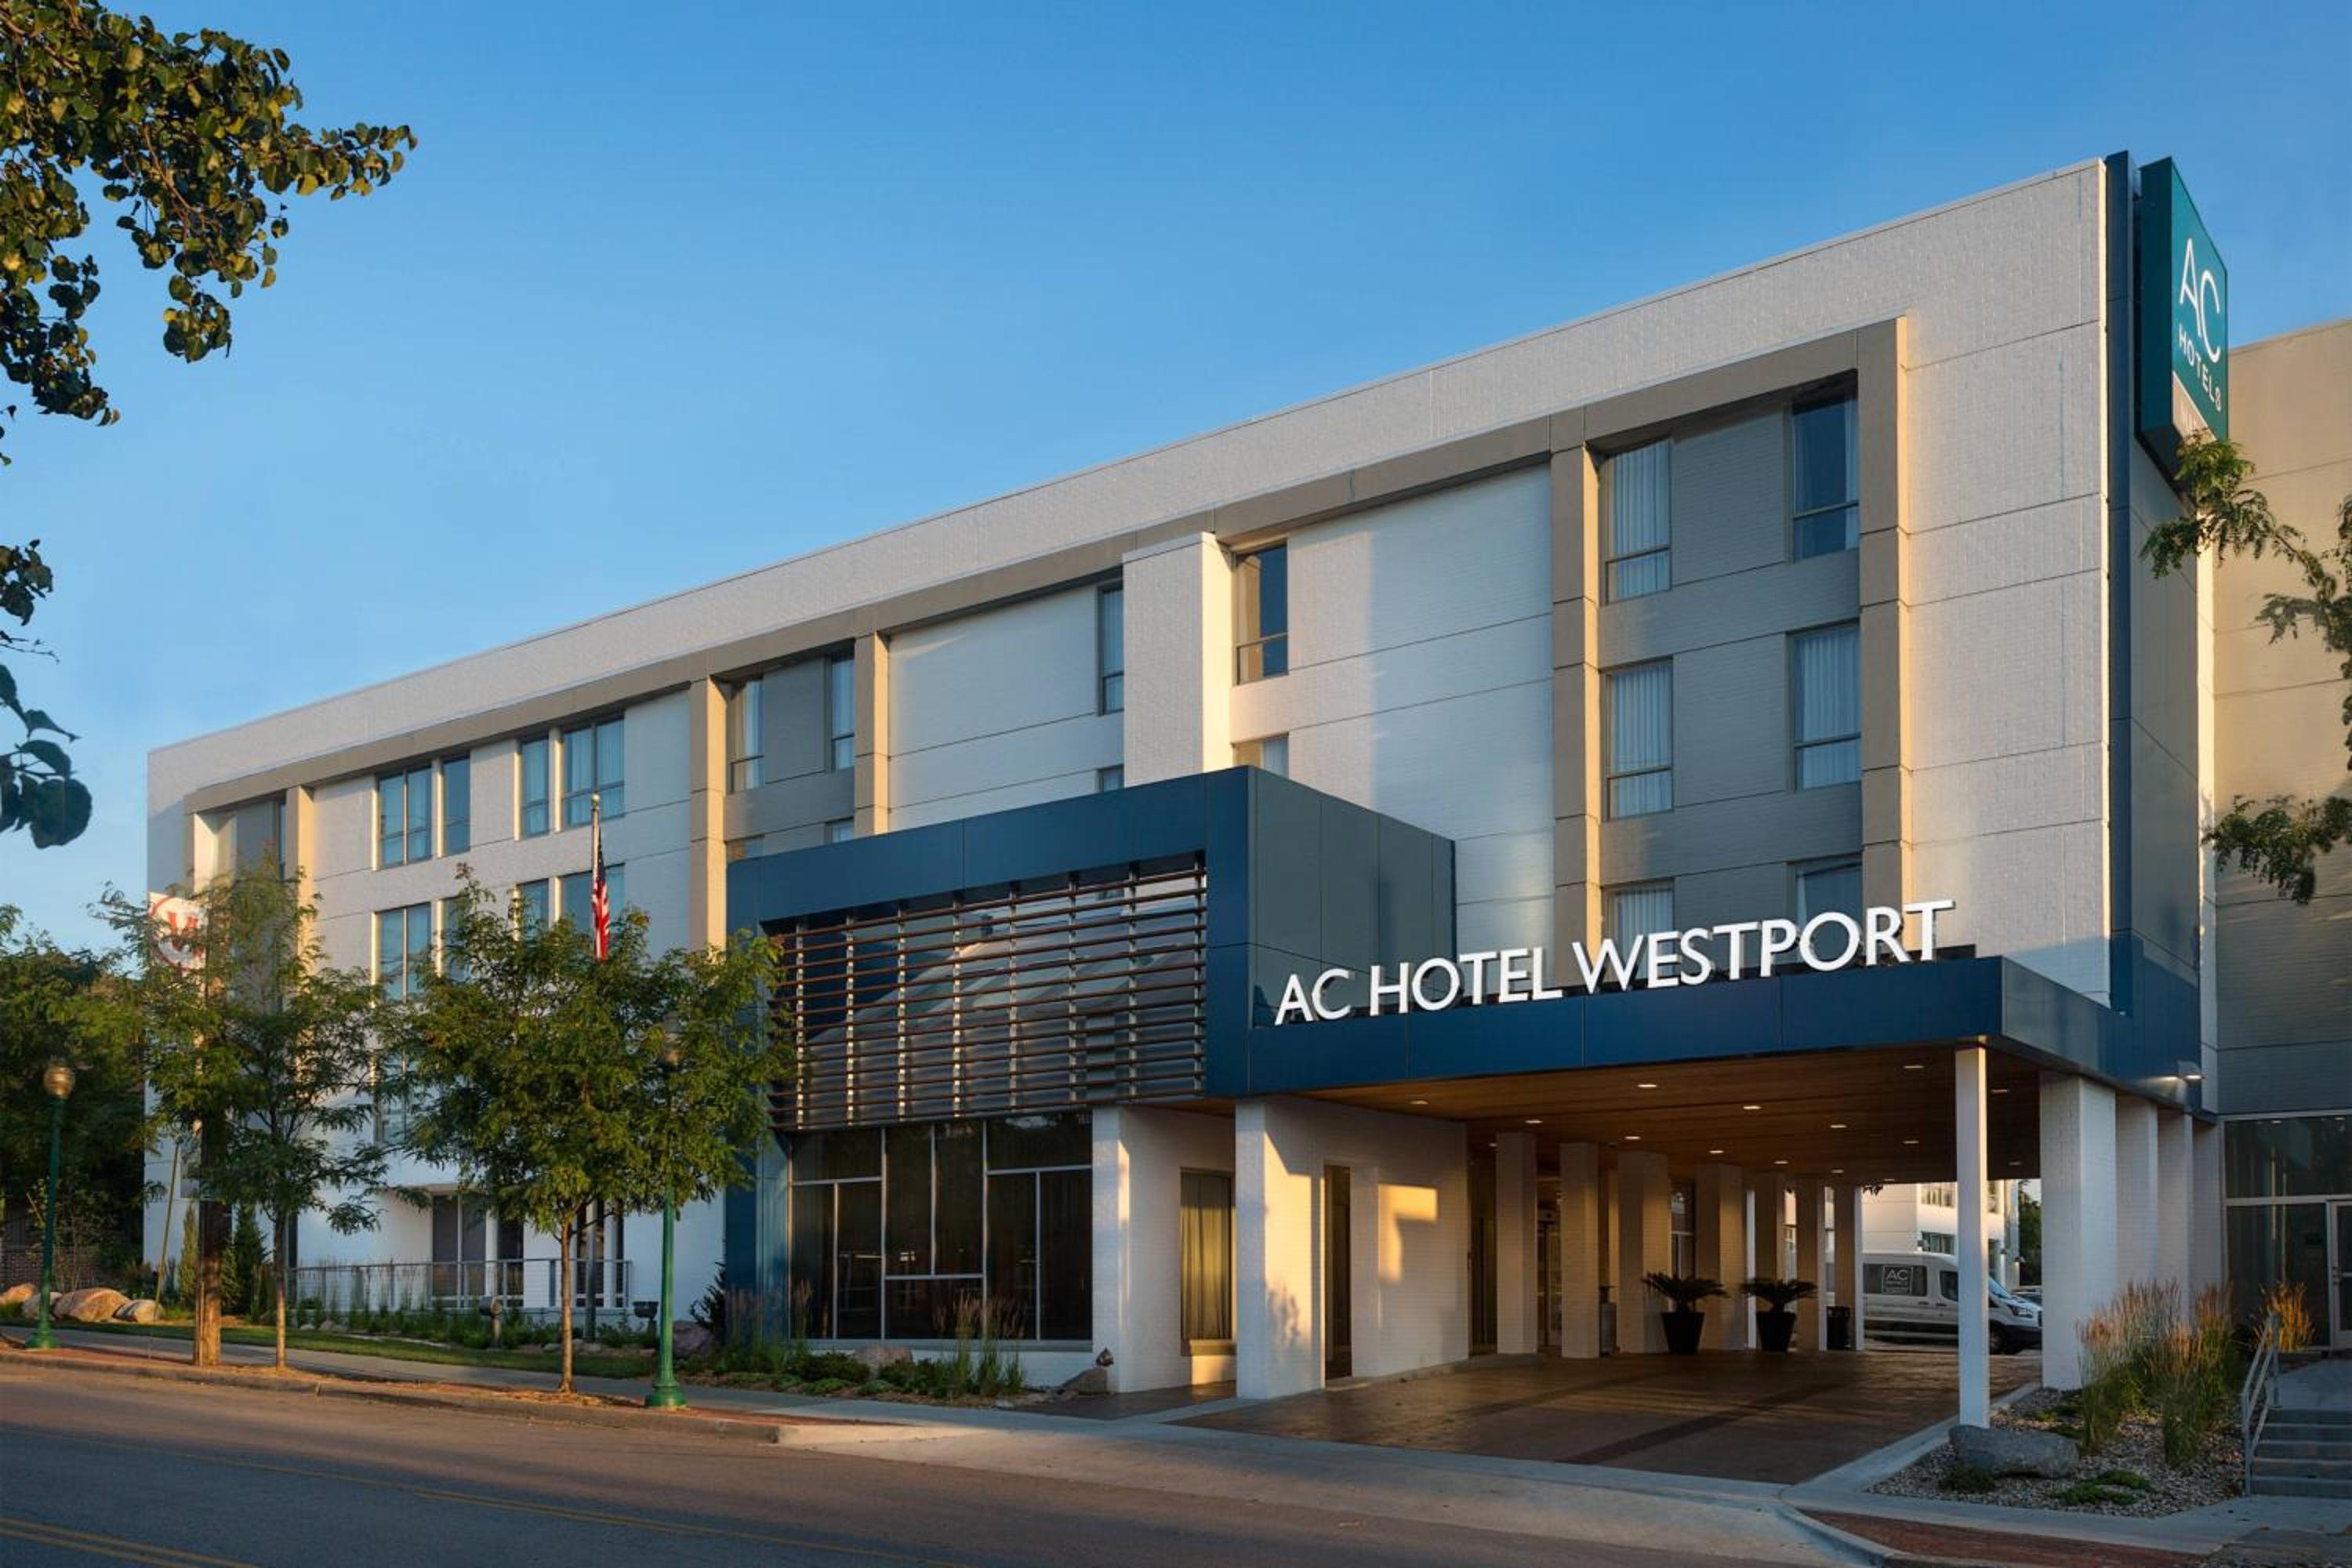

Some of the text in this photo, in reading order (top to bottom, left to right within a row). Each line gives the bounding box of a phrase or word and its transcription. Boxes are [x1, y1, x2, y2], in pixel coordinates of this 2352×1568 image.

[2179, 238, 2220, 364] AC
[2179, 323, 2221, 412] HOTELS
[1274, 899, 1956, 1026] AC HOTEL WESTPORT
[1886, 1269, 1908, 1280] AC
